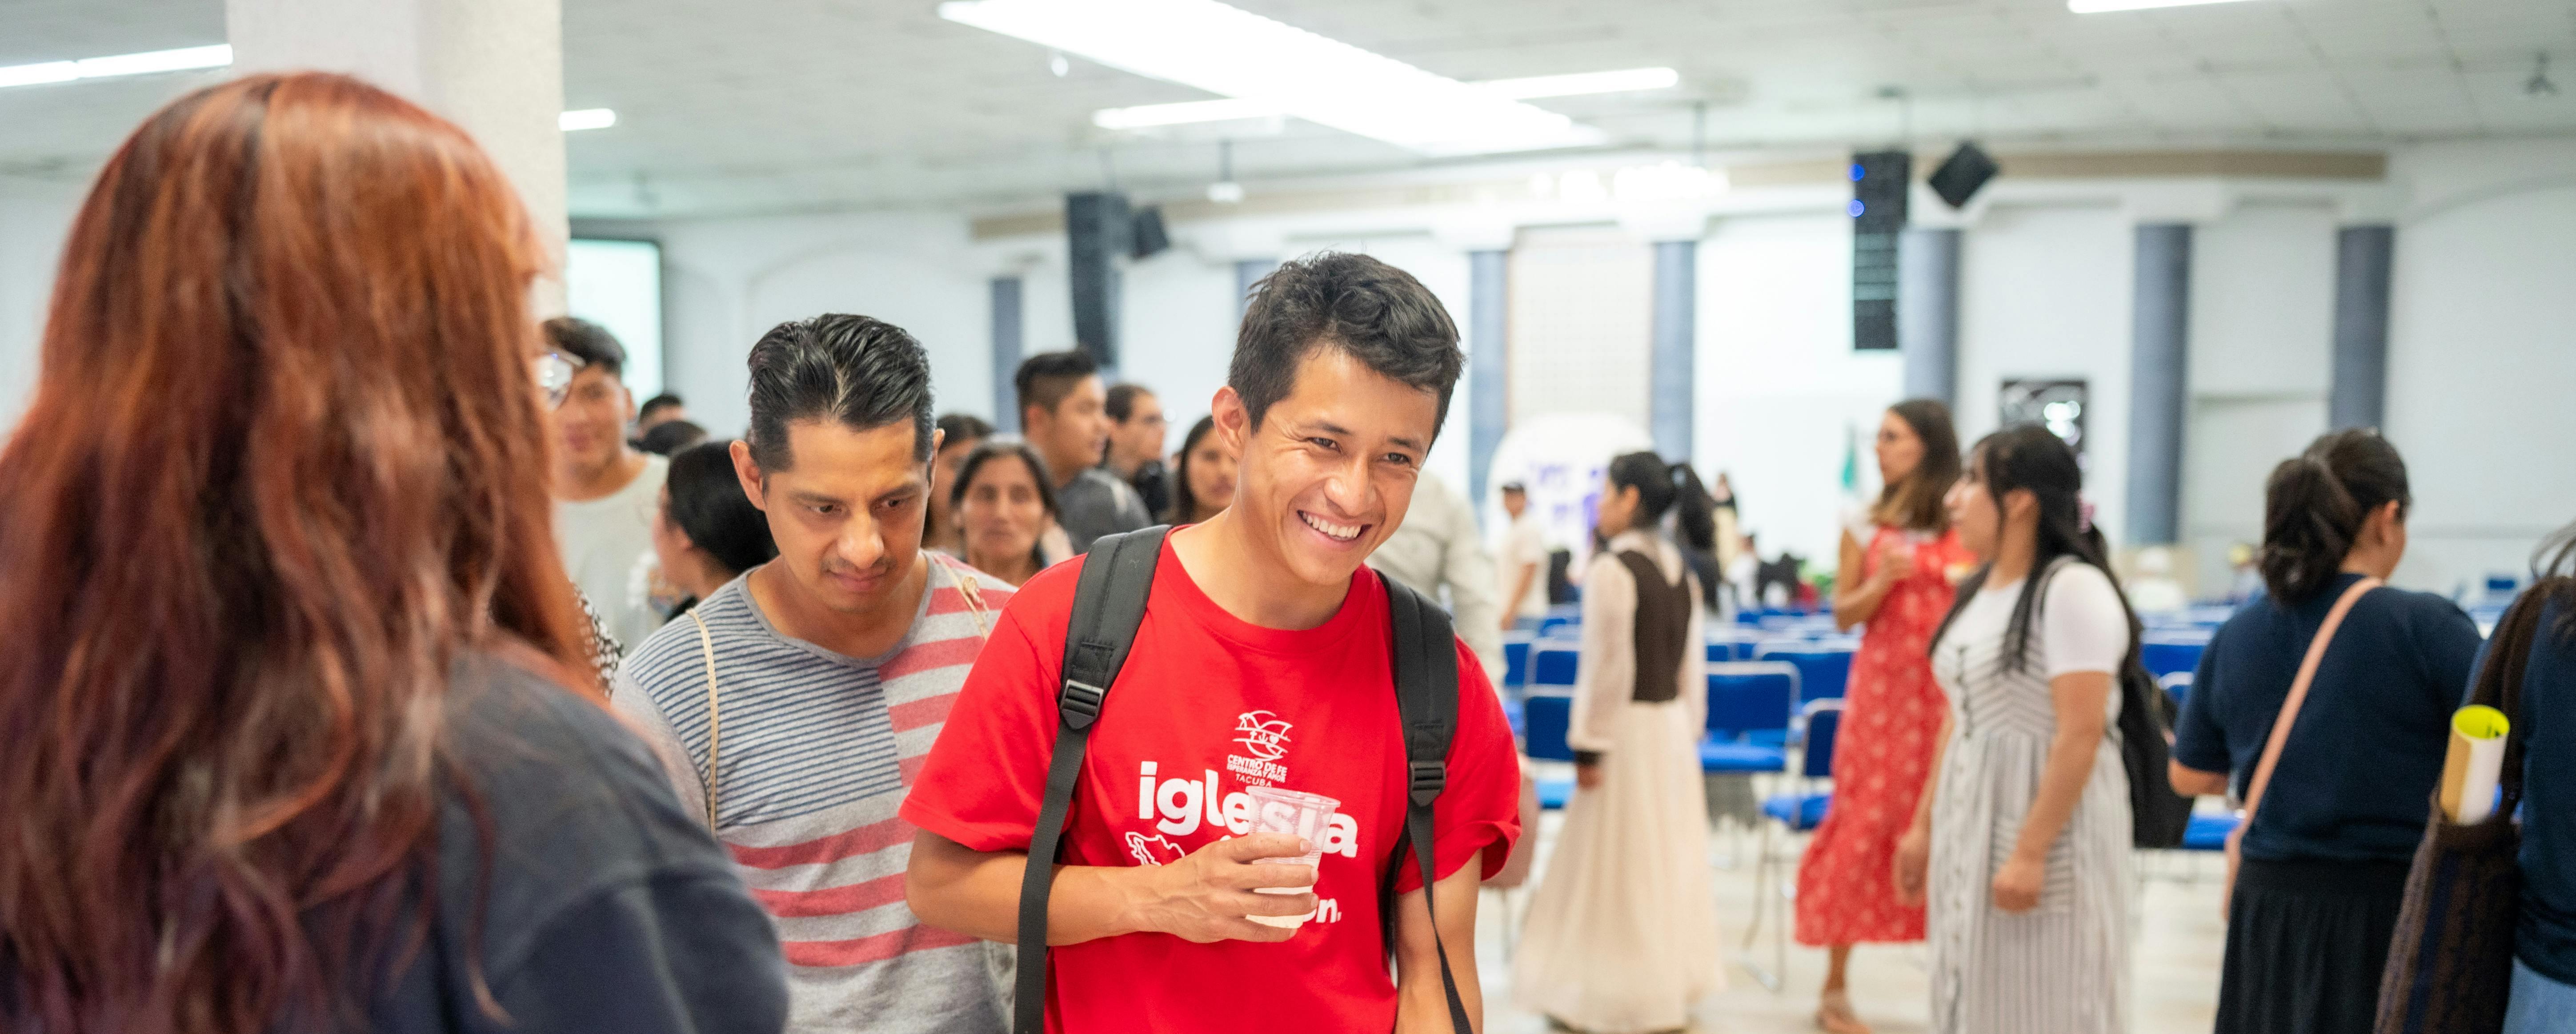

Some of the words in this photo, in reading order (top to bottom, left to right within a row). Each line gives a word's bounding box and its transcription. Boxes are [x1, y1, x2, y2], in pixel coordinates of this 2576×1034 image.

[1226, 763, 1262, 777] ESPERANZA
[1227, 754, 1263, 770] CENTRO
[1264, 762, 1278, 774] DE
[1276, 765, 1288, 777] FE
[1236, 773, 1272, 788] TACUBA
[1138, 761, 1358, 858] iglesia
